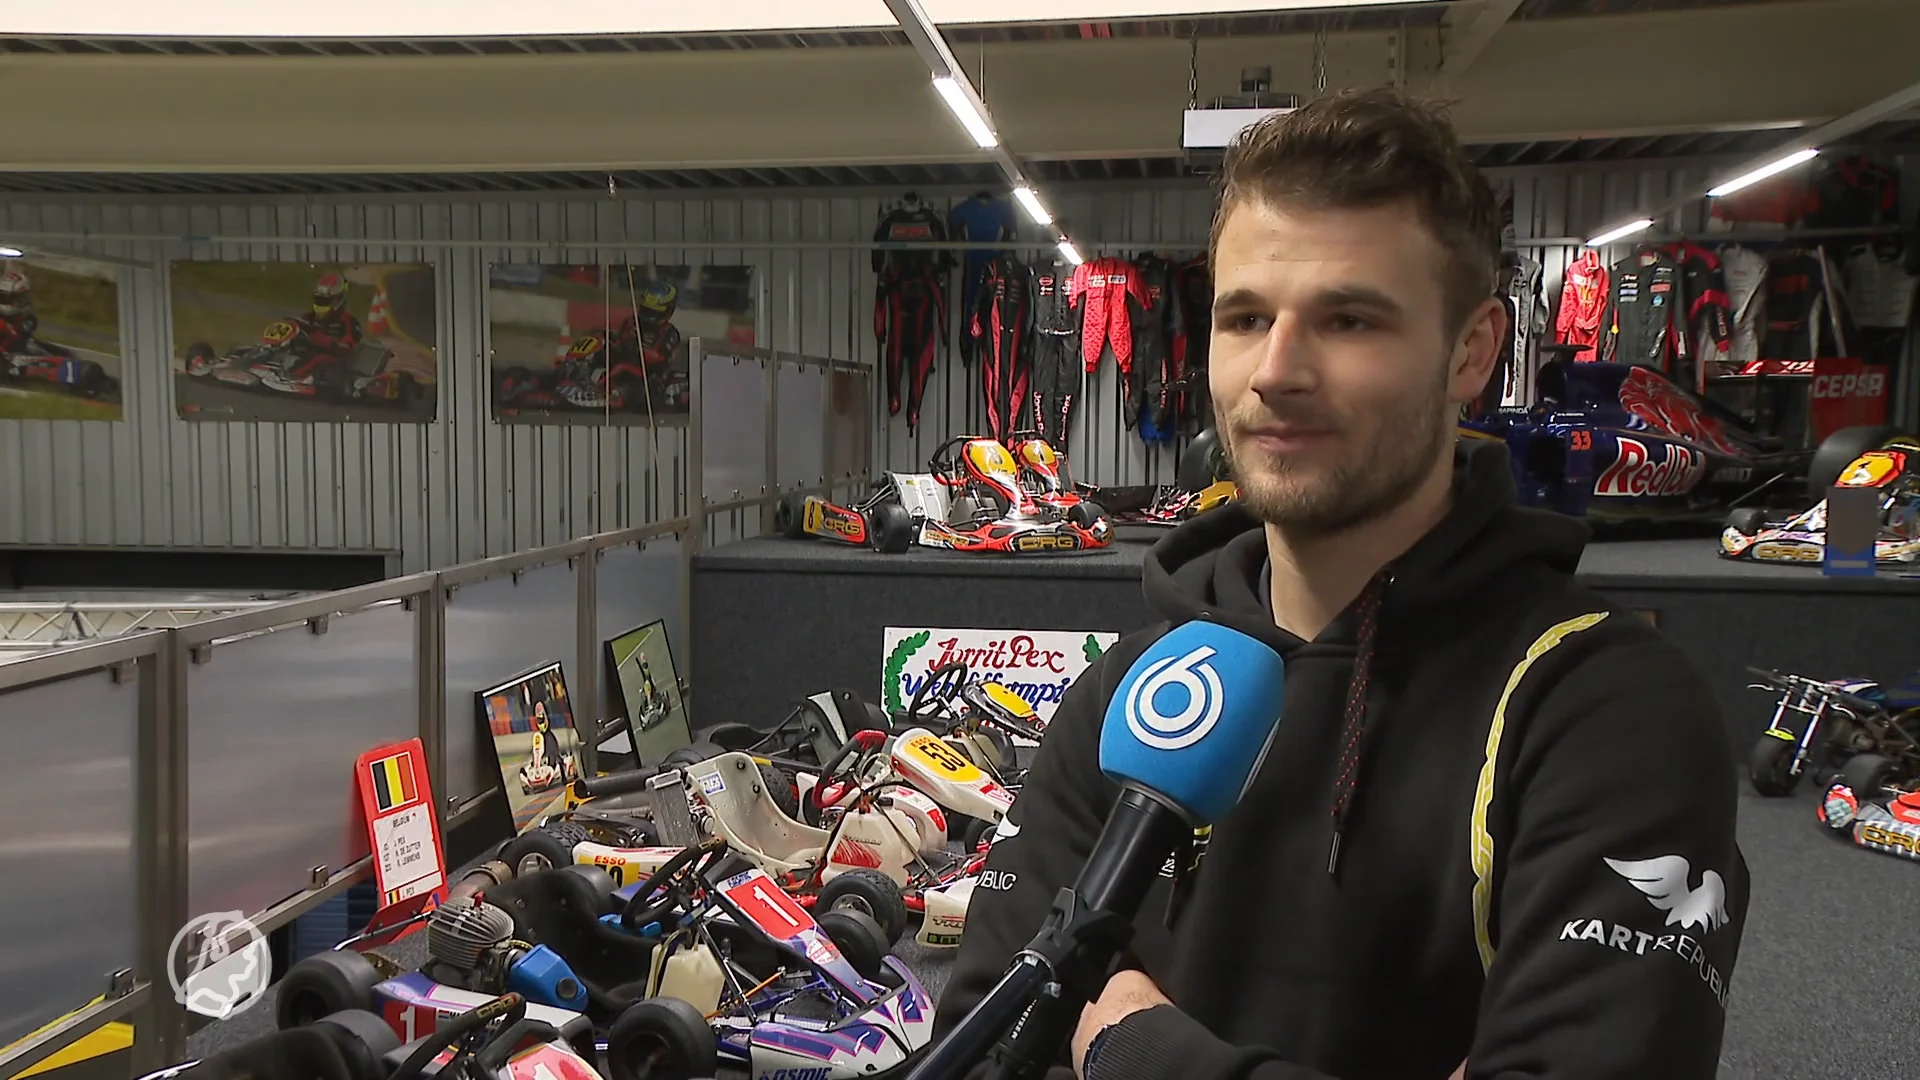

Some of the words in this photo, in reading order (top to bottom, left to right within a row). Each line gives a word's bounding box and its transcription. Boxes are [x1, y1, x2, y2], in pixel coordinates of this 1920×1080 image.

[1813, 373, 1884, 398] CEPSA
[1570, 431, 1592, 451] 33
[823, 517, 861, 535] CRG
[1019, 535, 1075, 551] CRG
[929, 637, 1007, 671] Jorrit
[1006, 634, 1066, 674] Pex
[919, 742, 966, 772] 53
[1863, 826, 1920, 854] CR
[594, 855, 627, 866] ESSO
[752, 885, 800, 927] 1
